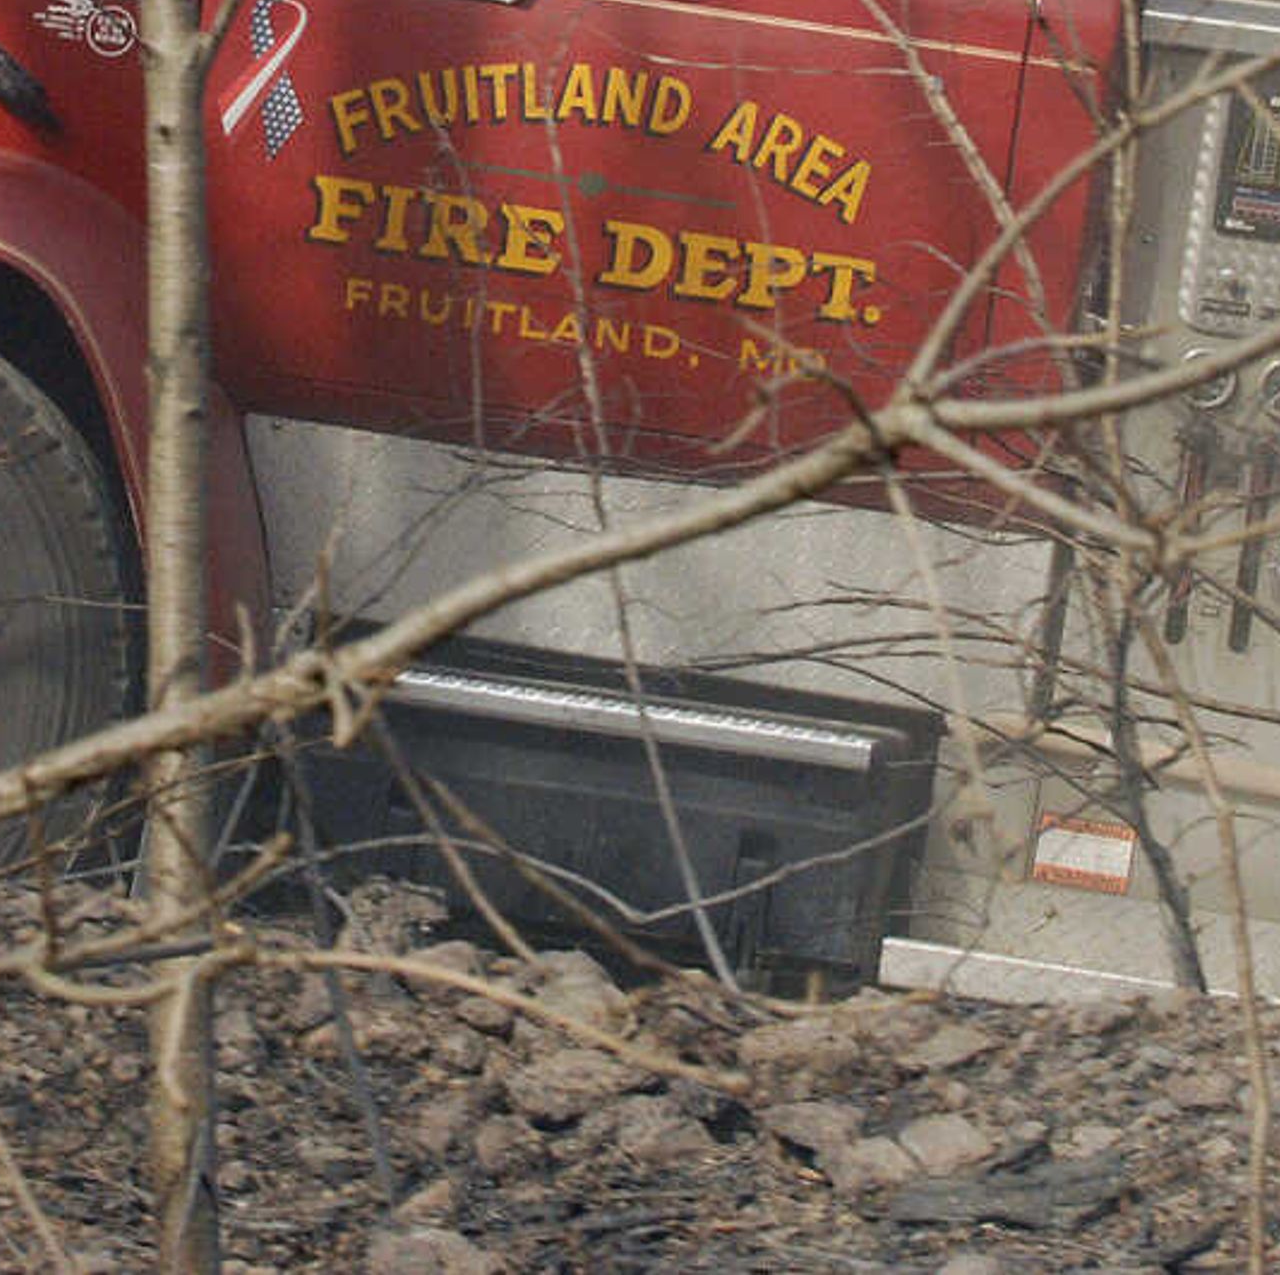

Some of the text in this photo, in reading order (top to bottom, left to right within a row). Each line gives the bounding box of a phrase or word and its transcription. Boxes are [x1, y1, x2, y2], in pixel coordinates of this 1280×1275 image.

[331, 62, 874, 224] FRUITLAND AREA
[309, 173, 884, 326] FIRE DEPT.
[346, 277, 700, 368] FRUITLAND,
